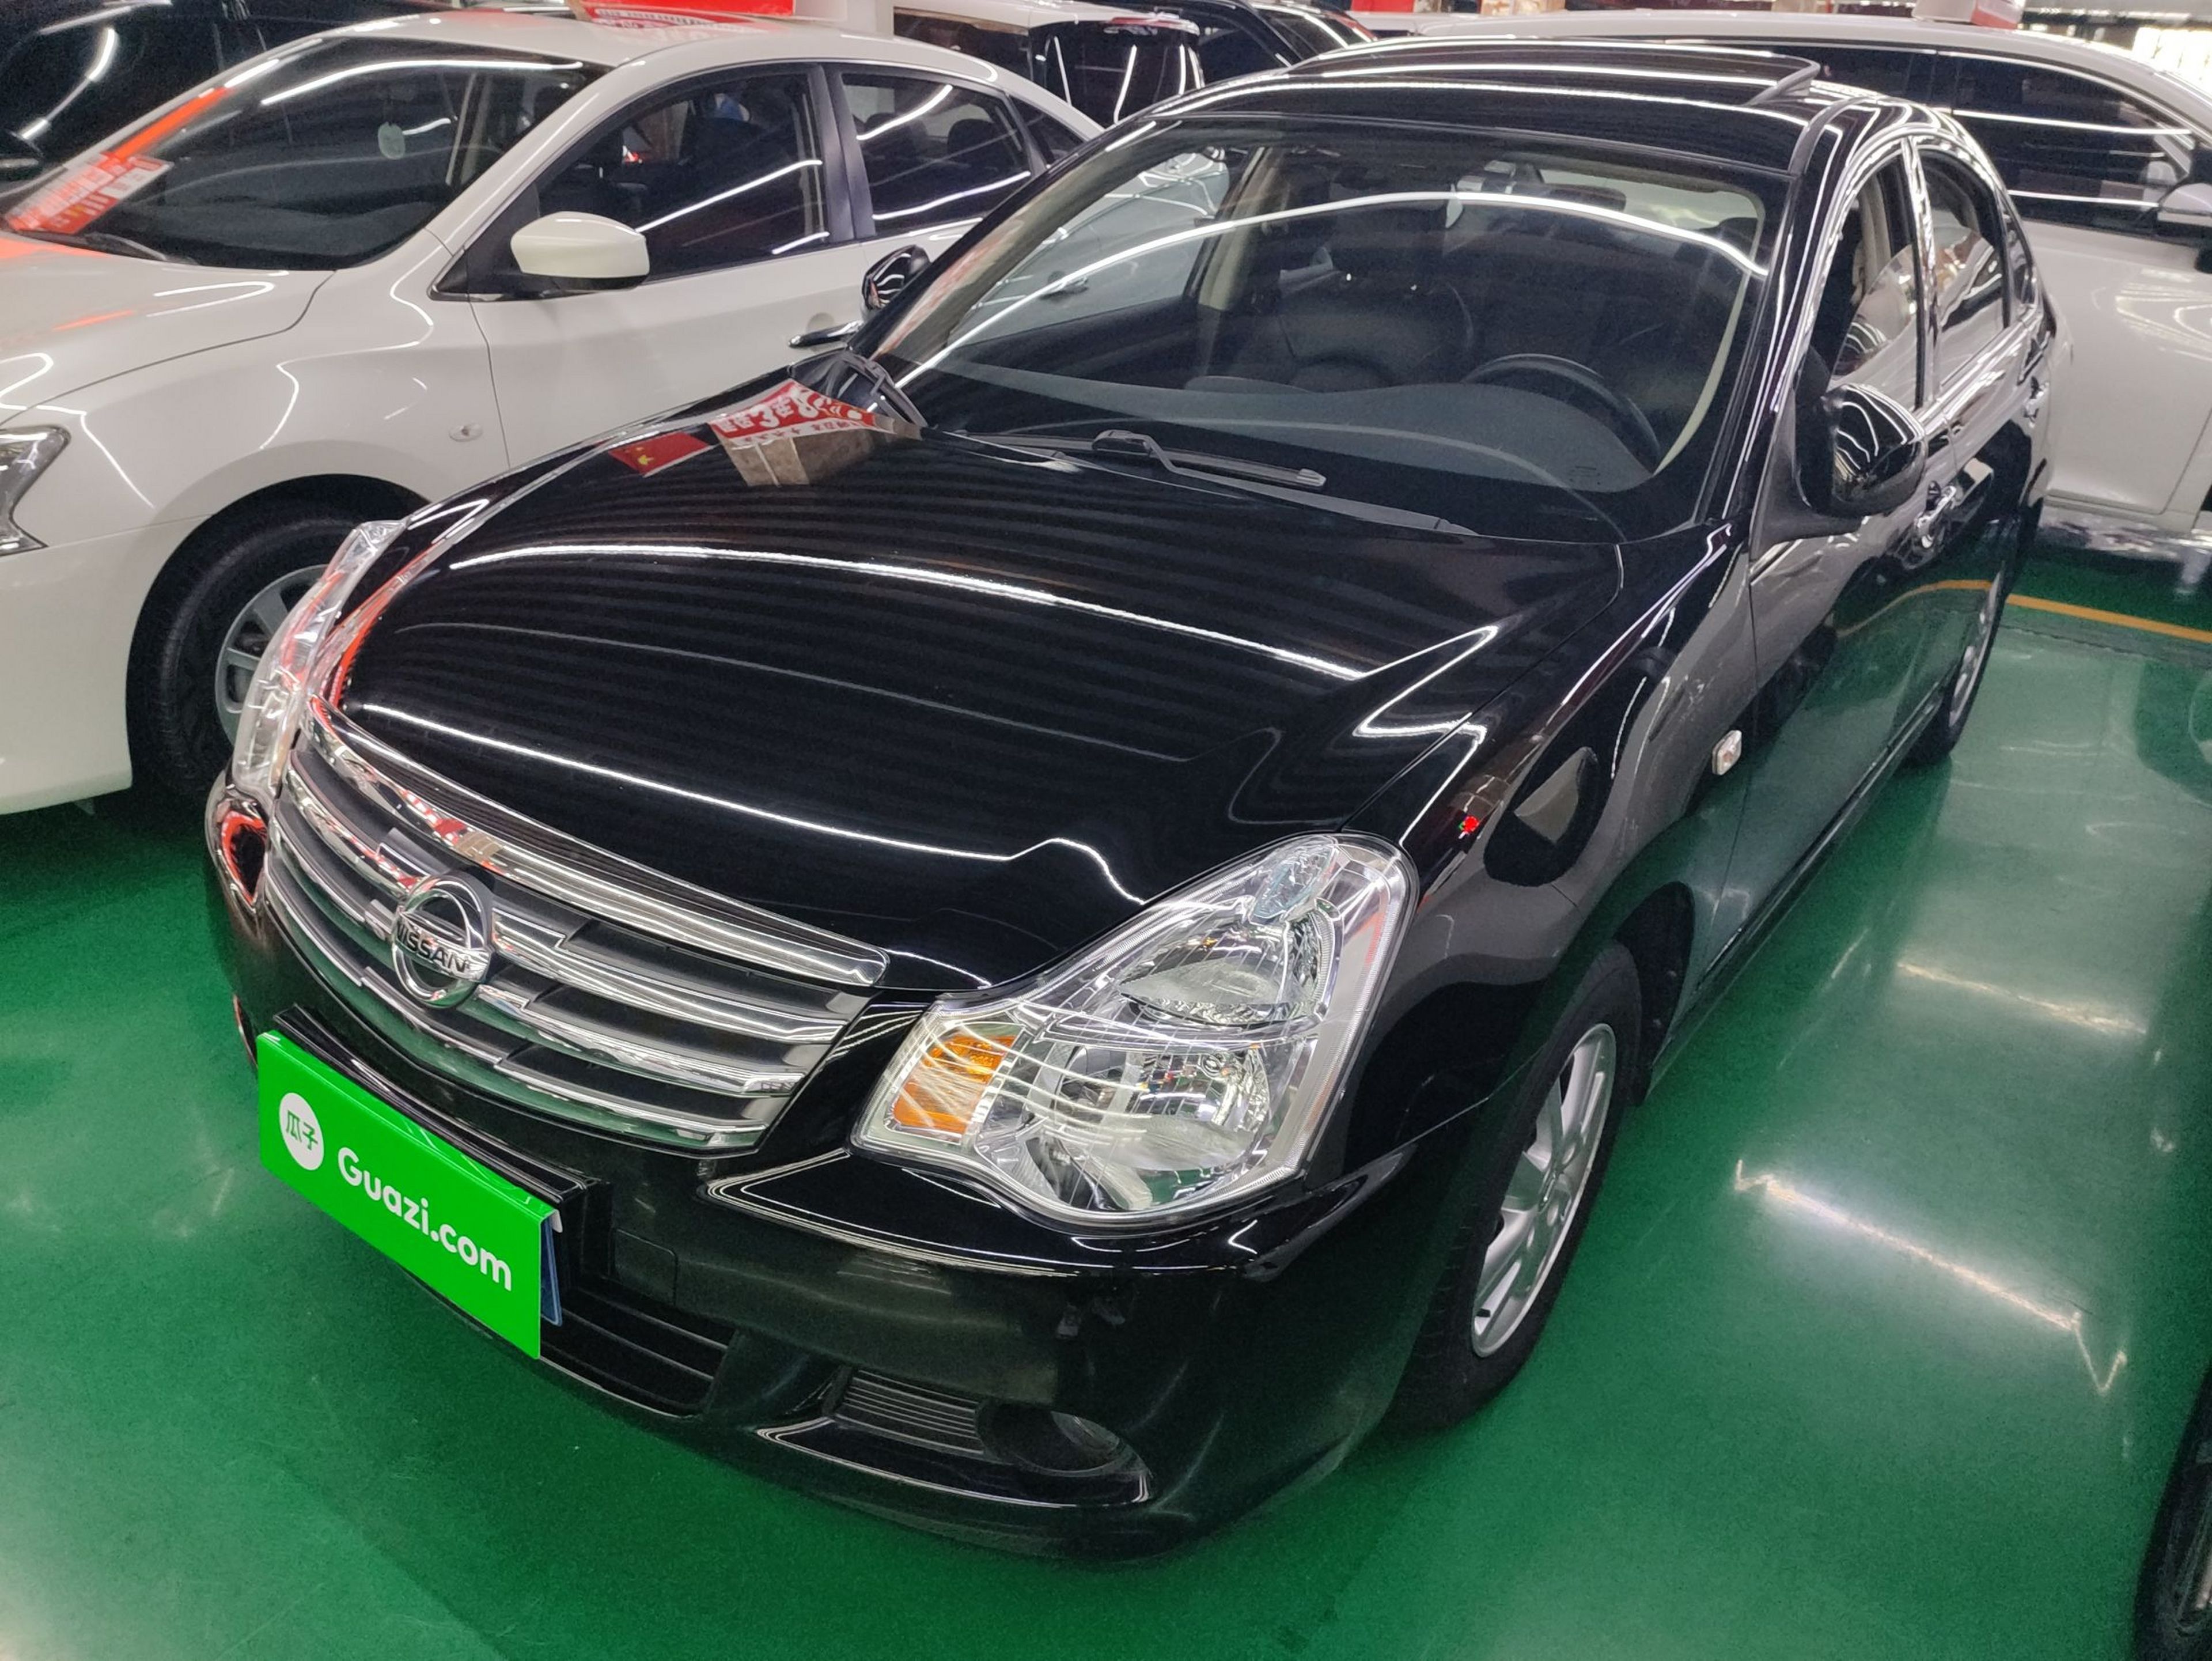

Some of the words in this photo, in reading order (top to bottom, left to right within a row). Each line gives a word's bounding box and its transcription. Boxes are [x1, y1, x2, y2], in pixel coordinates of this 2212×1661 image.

[396, 918, 469, 974] NISSAN
[286, 1110, 319, 1151] 瓜子
[338, 1147, 512, 1291] Guazi.com
